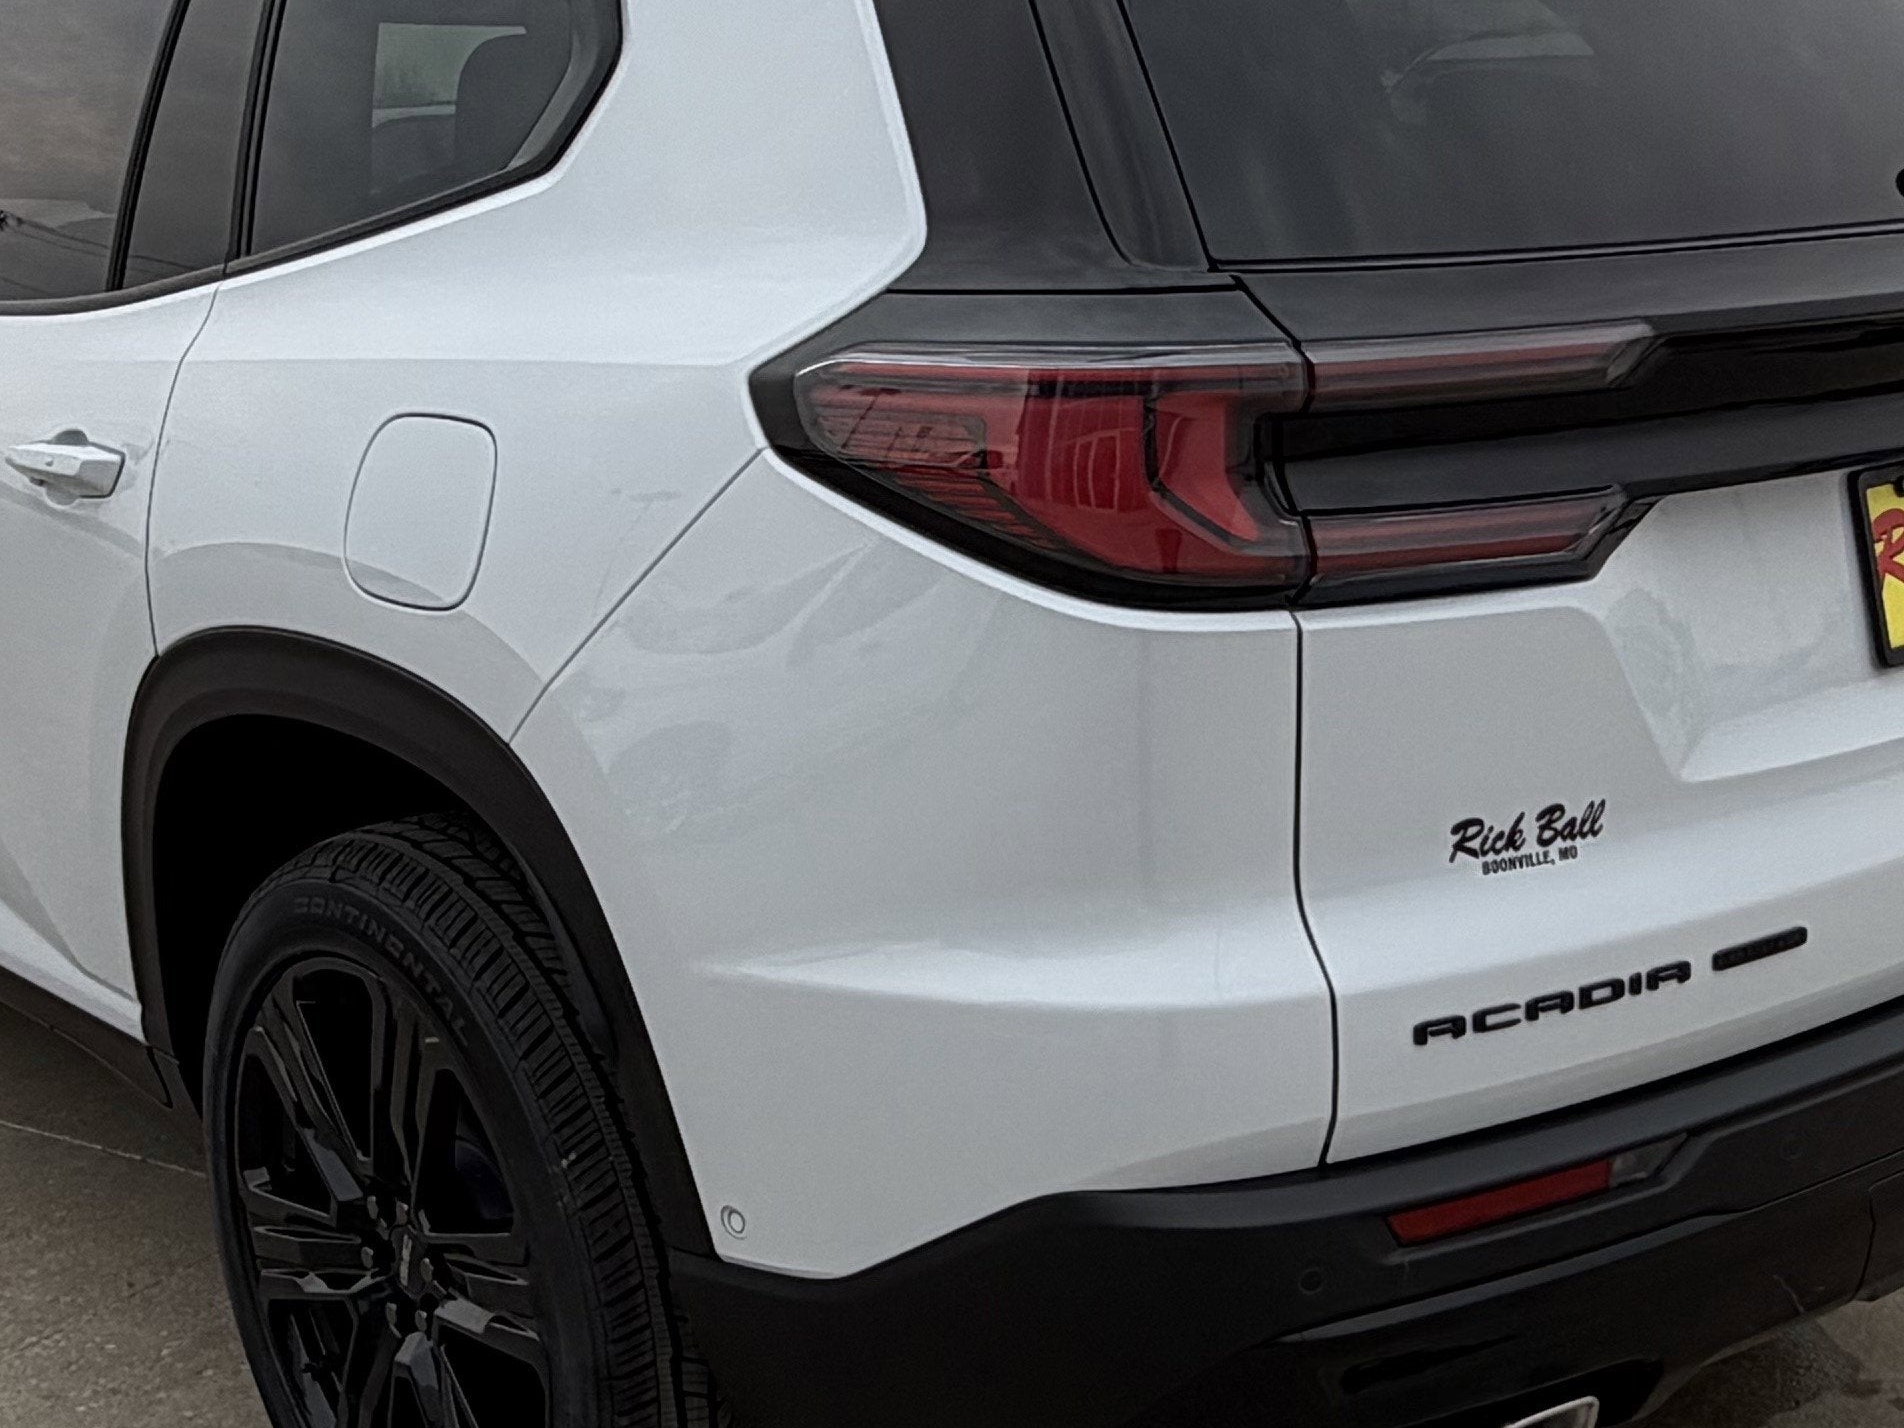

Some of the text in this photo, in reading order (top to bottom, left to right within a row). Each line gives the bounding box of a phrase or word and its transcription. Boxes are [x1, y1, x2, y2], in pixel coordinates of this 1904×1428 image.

[1448, 798, 1606, 863] Rick Ball
[1481, 844, 1579, 876] BOONVILLE, MO
[1412, 959, 1692, 1047] ACADIA
